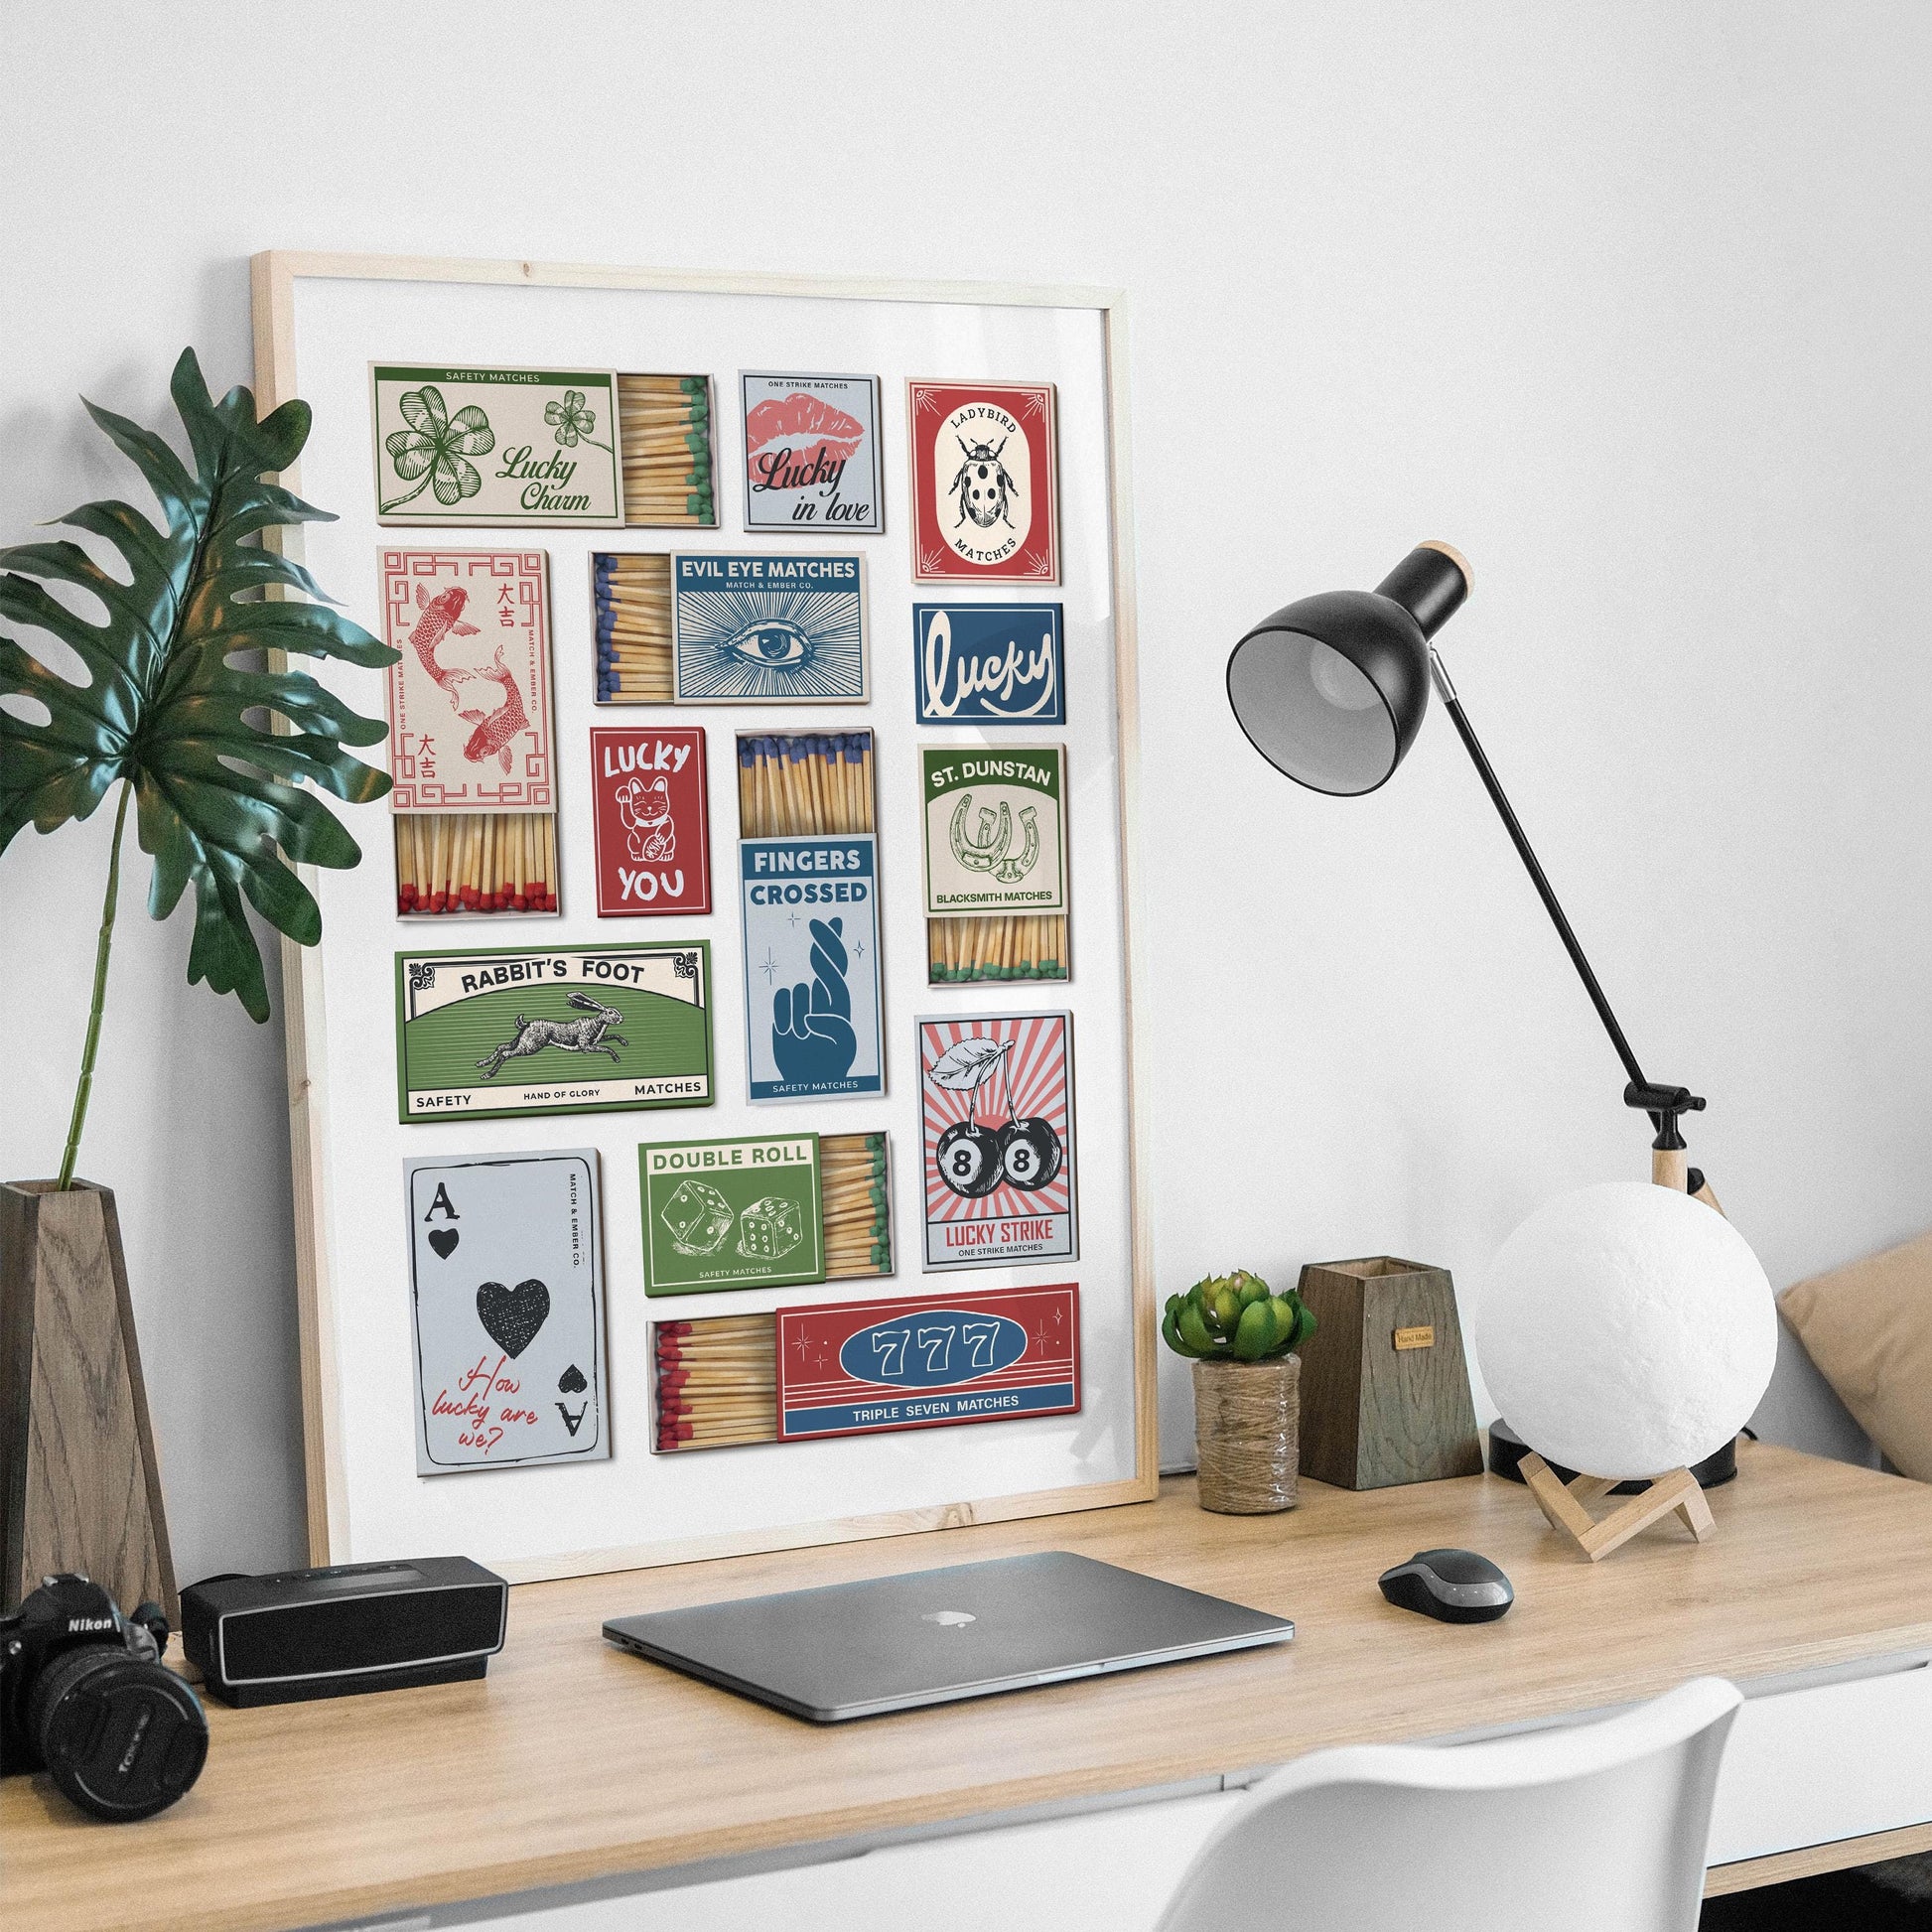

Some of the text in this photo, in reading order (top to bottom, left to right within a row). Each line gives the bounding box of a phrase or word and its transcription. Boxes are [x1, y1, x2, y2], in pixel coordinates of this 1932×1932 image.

[446, 371, 540, 383] SAFETY MATCHES
[950, 407, 1017, 433] LADYBIRD
[495, 446, 579, 489] Lucky
[753, 447, 847, 497] Lucky
[520, 483, 592, 511] Charm
[792, 492, 870, 521] in love
[954, 538, 1017, 562] MATCHES
[682, 561, 855, 578] EVIL EYE MATCHES
[496, 583, 515, 627] 大吉
[923, 611, 1054, 717] lucky
[418, 734, 436, 778] 大吉
[605, 740, 691, 777] LUCKY
[931, 760, 1050, 787] ST. DUNSTAN
[755, 849, 861, 873] FINGERS
[618, 867, 684, 900] YOU
[750, 883, 867, 905] CROSSED
[937, 891, 1052, 903] BLACKSMITH MATCHES
[462, 959, 644, 993] RABBIT'S FOOT
[568, 1089, 600, 1098] GLORY
[634, 1082, 701, 1095] MATCHES
[772, 1080, 859, 1093] SAFETY MATCHES
[416, 1094, 472, 1108] SAFETY
[653, 1146, 807, 1171] DOUBLE ROLL
[952, 1150, 971, 1176] 8
[1013, 1149, 1031, 1173] 8
[424, 1181, 461, 1222] A
[946, 1219, 1053, 1248] LUCKY STRIKE
[958, 1243, 1043, 1257] ONE STRIKE MATCHES
[699, 1266, 772, 1279] SAFETY MATCHES
[458, 1354, 521, 1401] How
[432, 1390, 539, 1429] lucky are
[554, 1401, 588, 1437] A
[853, 1395, 1020, 1422] TRIPLE SEVEN MATCHES
[458, 1427, 504, 1455] we?
[69, 1618, 112, 1632] Nikon
